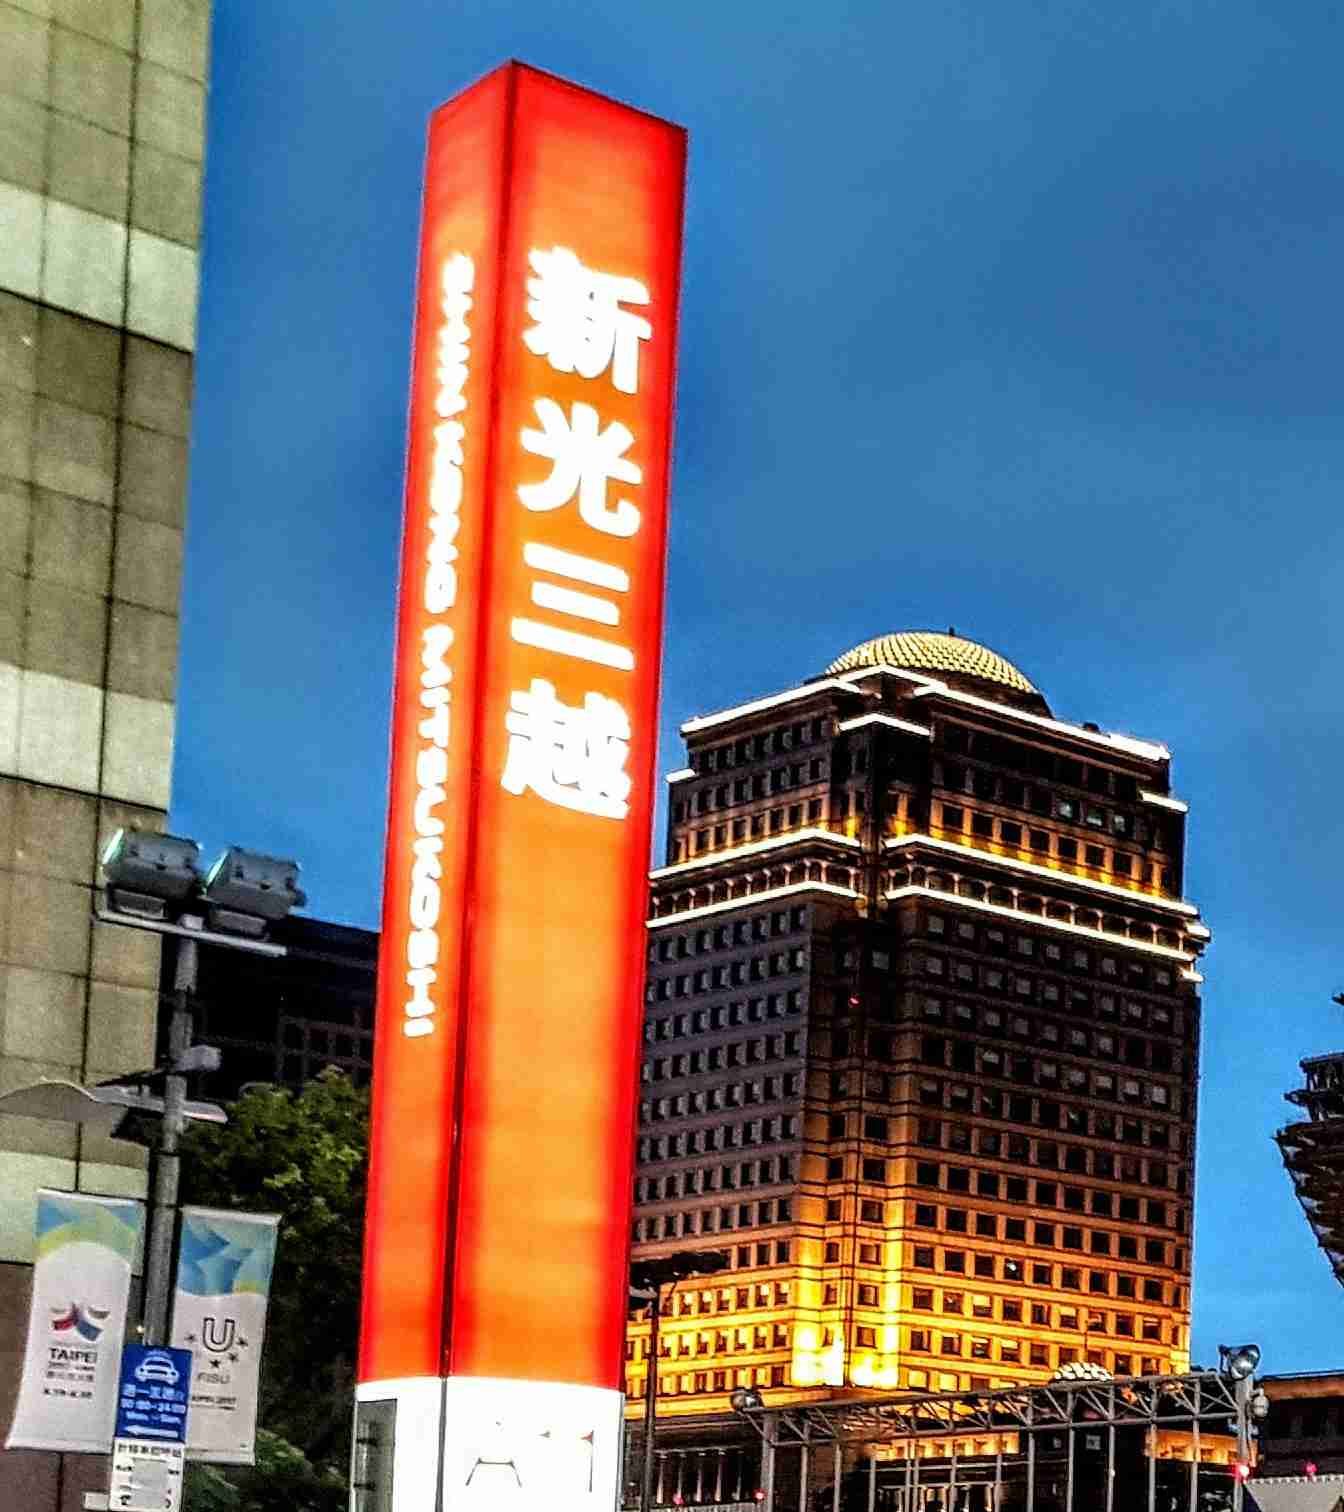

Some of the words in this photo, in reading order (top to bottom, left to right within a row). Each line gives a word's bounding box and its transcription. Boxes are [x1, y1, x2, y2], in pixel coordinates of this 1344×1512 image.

[501, 245, 653, 821] 新光三越
[403, 623, 456, 1038] MITSUKOSHI
[49, 1347, 98, 1363] TAIPEI
